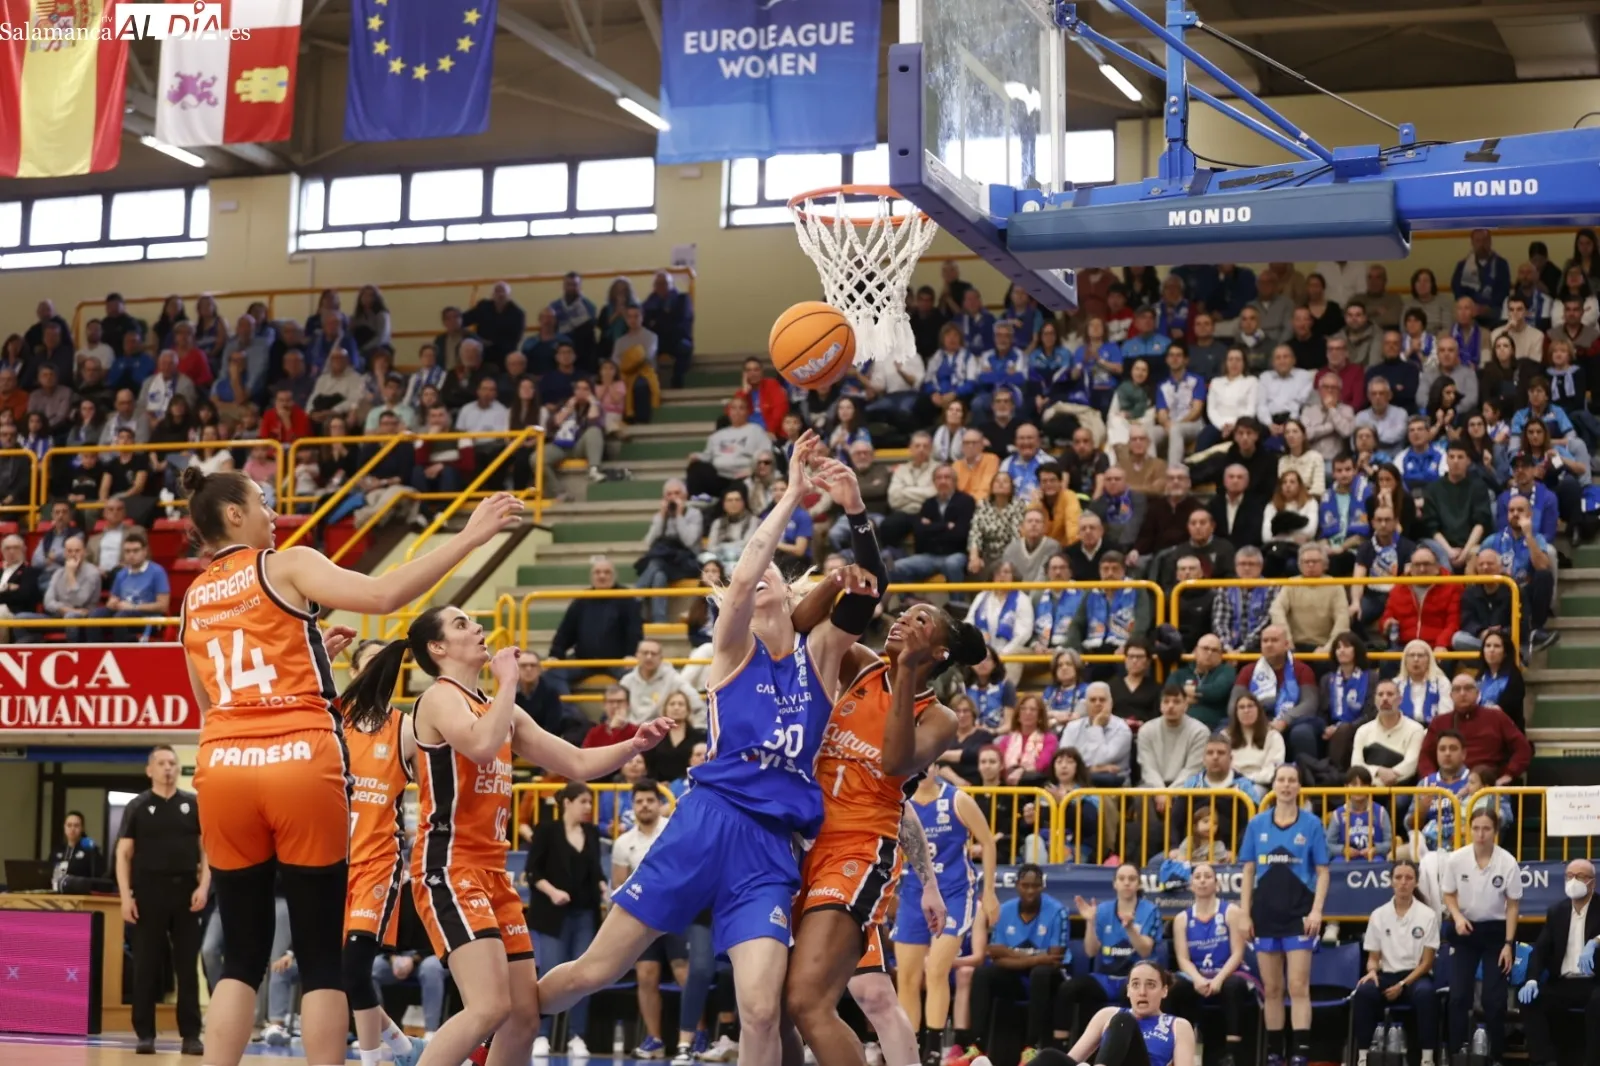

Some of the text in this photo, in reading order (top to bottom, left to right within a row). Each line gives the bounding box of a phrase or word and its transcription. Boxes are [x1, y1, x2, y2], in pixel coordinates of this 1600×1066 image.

[684, 21, 855, 54] EUROLEAGUE
[718, 52, 817, 80] WOMEN
[1452, 179, 1540, 198] MONDO
[1167, 206, 1253, 227] MONDO
[188, 564, 256, 611] CARRERA
[206, 627, 278, 707] 14
[208, 739, 313, 769] PAMESA
